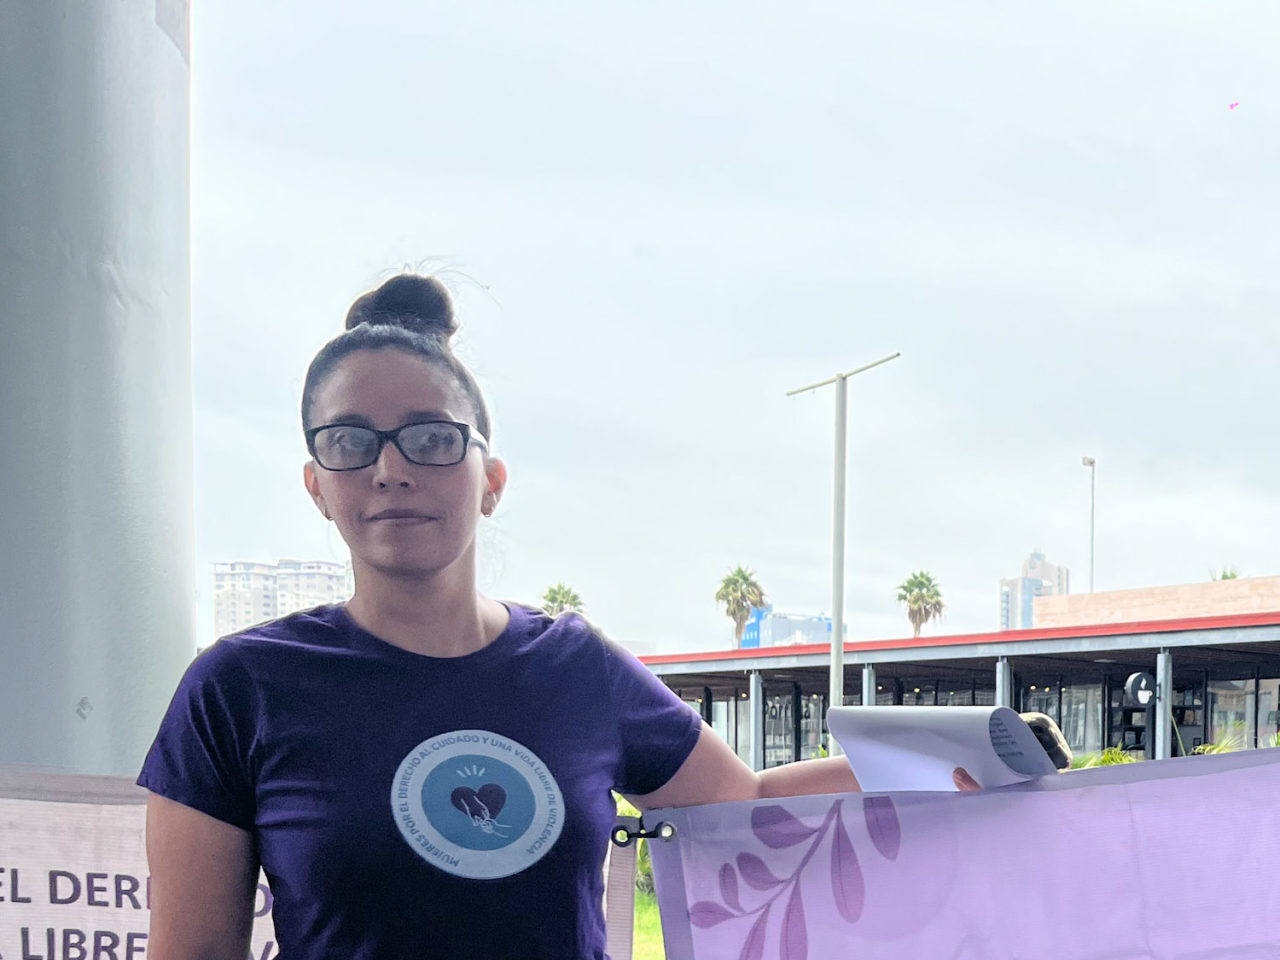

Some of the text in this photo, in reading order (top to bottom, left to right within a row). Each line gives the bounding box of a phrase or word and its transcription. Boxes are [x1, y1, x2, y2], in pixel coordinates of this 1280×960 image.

[398, 735, 558, 867] MUJERES POR EL DERECHO AL CUIDADO Y UNA VIDA LIBRE DE VIOLENCIA
[0, 867, 32, 904] L
